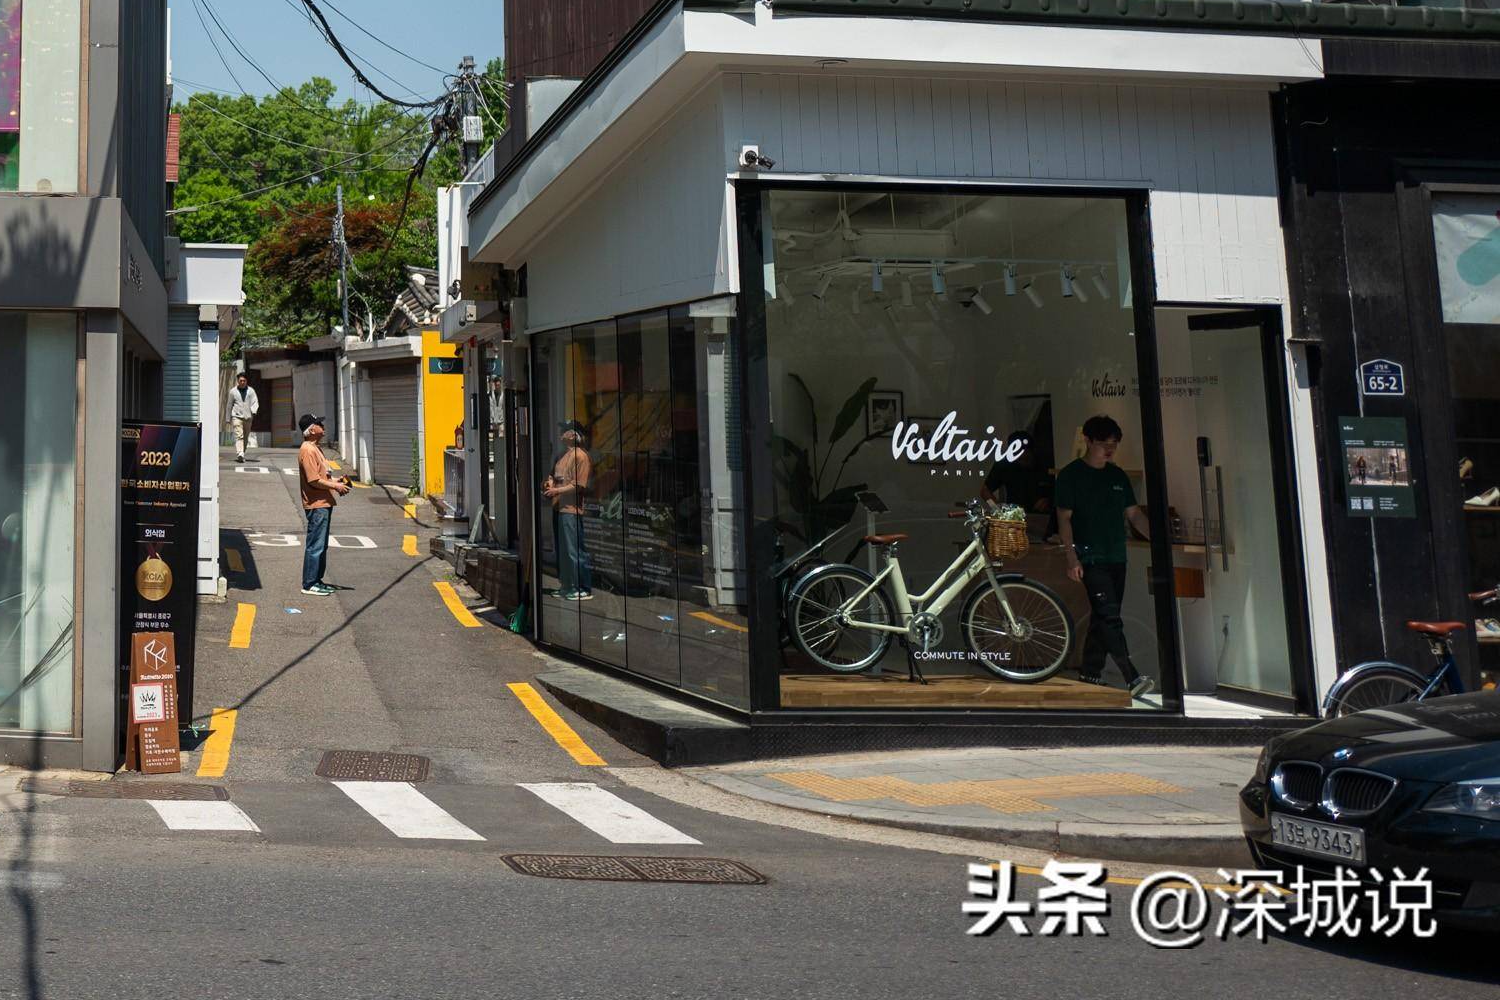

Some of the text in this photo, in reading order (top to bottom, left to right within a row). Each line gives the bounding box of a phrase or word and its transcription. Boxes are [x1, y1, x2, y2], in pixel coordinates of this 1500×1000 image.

[1369, 376, 1398, 390] 65-2
[892, 410, 1025, 462] Voltaire
[141, 451, 171, 466] 2023
[914, 651, 1011, 660] COMMUTE IN STYLE
